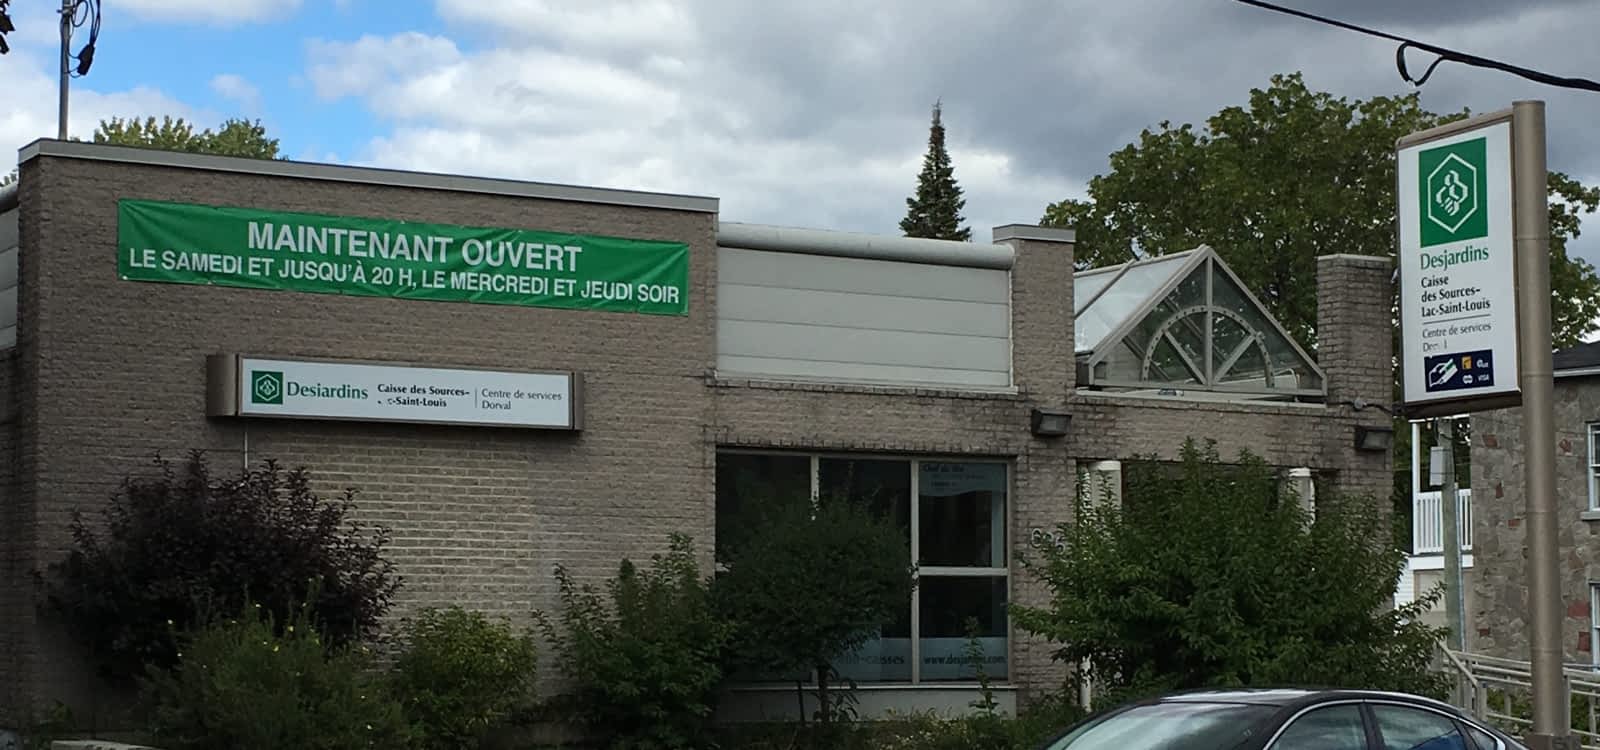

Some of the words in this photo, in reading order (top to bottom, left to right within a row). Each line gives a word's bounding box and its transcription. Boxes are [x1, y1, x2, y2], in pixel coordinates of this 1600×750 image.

[247, 221, 453, 264] MAINTENANT
[461, 238, 582, 273] OUVERT
[1420, 245, 1489, 272] Desjardins
[129, 247, 156, 269] LE
[160, 249, 243, 275] SAMEDI
[248, 256, 275, 276] ET
[278, 259, 367, 284] JUSQU'À
[371, 266, 394, 286] 20
[398, 268, 418, 290] H,
[422, 270, 446, 289] LE
[451, 271, 549, 296] MERCREDI
[553, 278, 577, 298] ET
[581, 280, 633, 301] JEUDI
[637, 283, 680, 304] SOIR
[1421, 274, 1449, 289] Caisse
[1421, 289, 1436, 303] des
[1439, 284, 1481, 301] Sources-
[1422, 297, 1491, 318] Lac-Saint-Louis
[1422, 327, 1448, 339] Centre
[1448, 324, 1458, 336] de
[377, 383, 408, 394] Caisse
[410, 384, 427, 394] des
[429, 386, 470, 397] Sources-
[481, 387, 512, 399] Centre
[513, 388, 525, 399] de
[527, 391, 562, 401] services
[481, 399, 511, 410] Dorval
